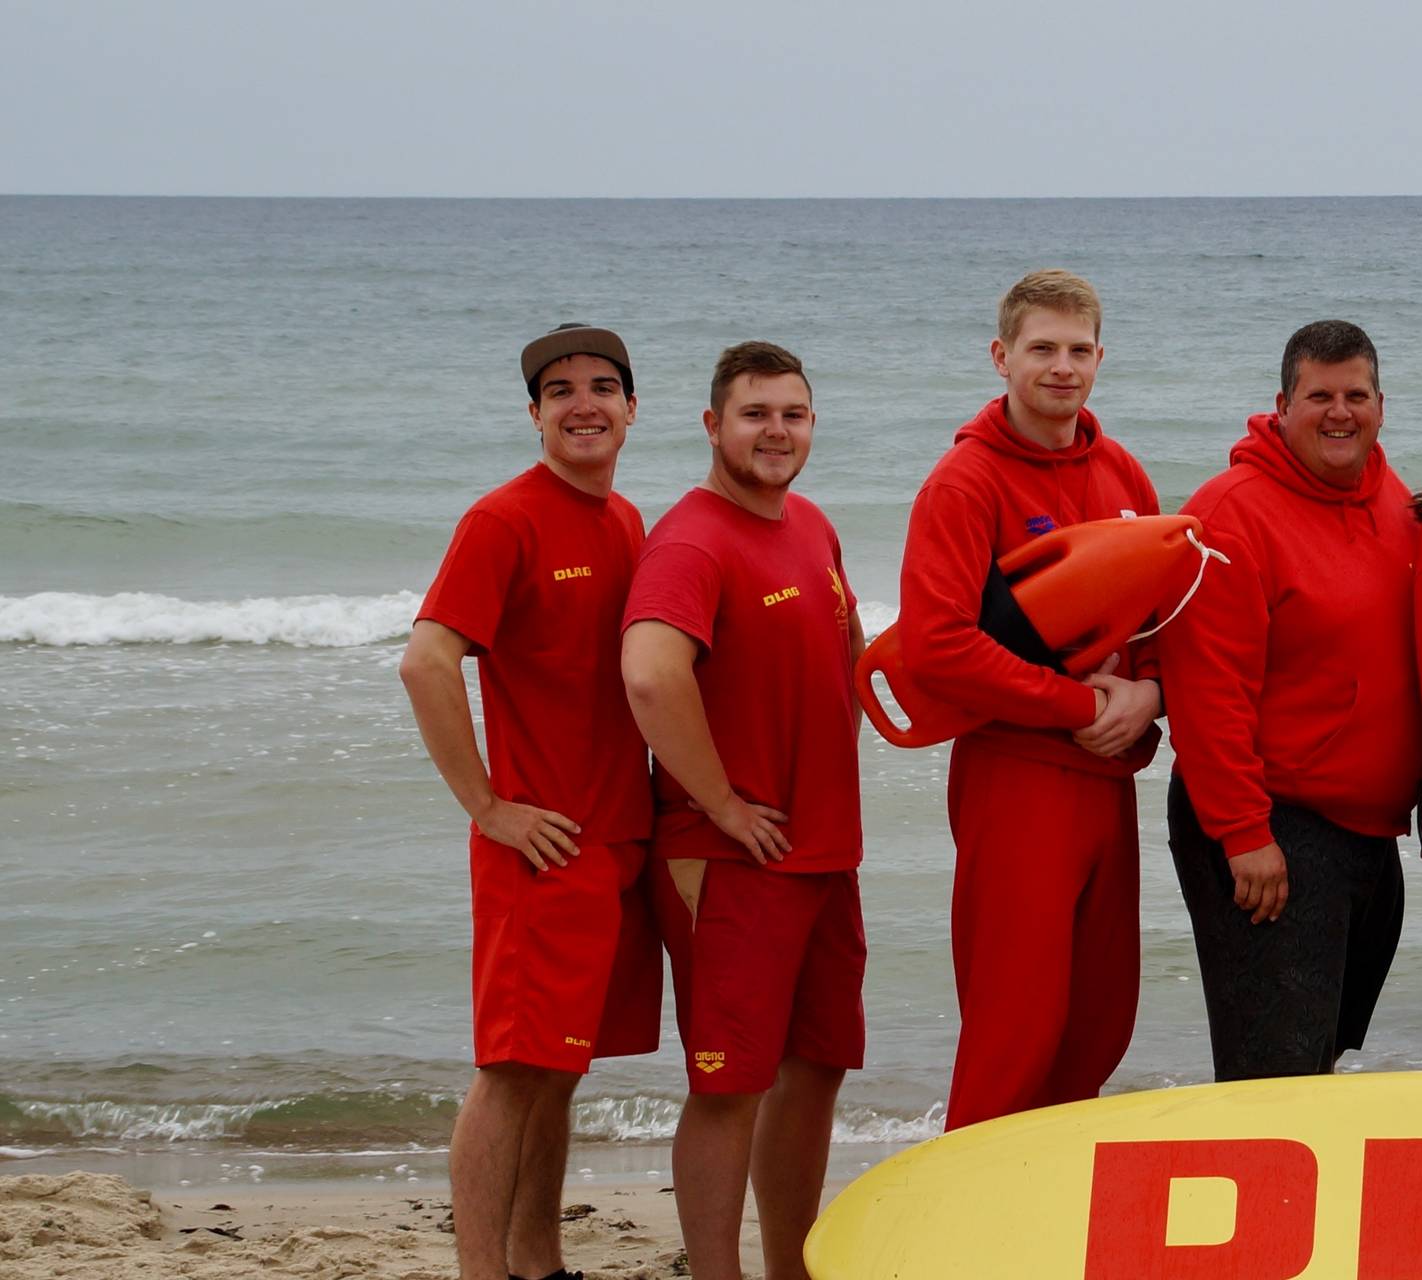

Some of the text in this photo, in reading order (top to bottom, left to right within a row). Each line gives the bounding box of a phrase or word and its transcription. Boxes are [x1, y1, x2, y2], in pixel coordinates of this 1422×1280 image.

[553, 566, 592, 581] DLRG
[762, 586, 801, 607] DLRG
[694, 1051, 725, 1061] arena
